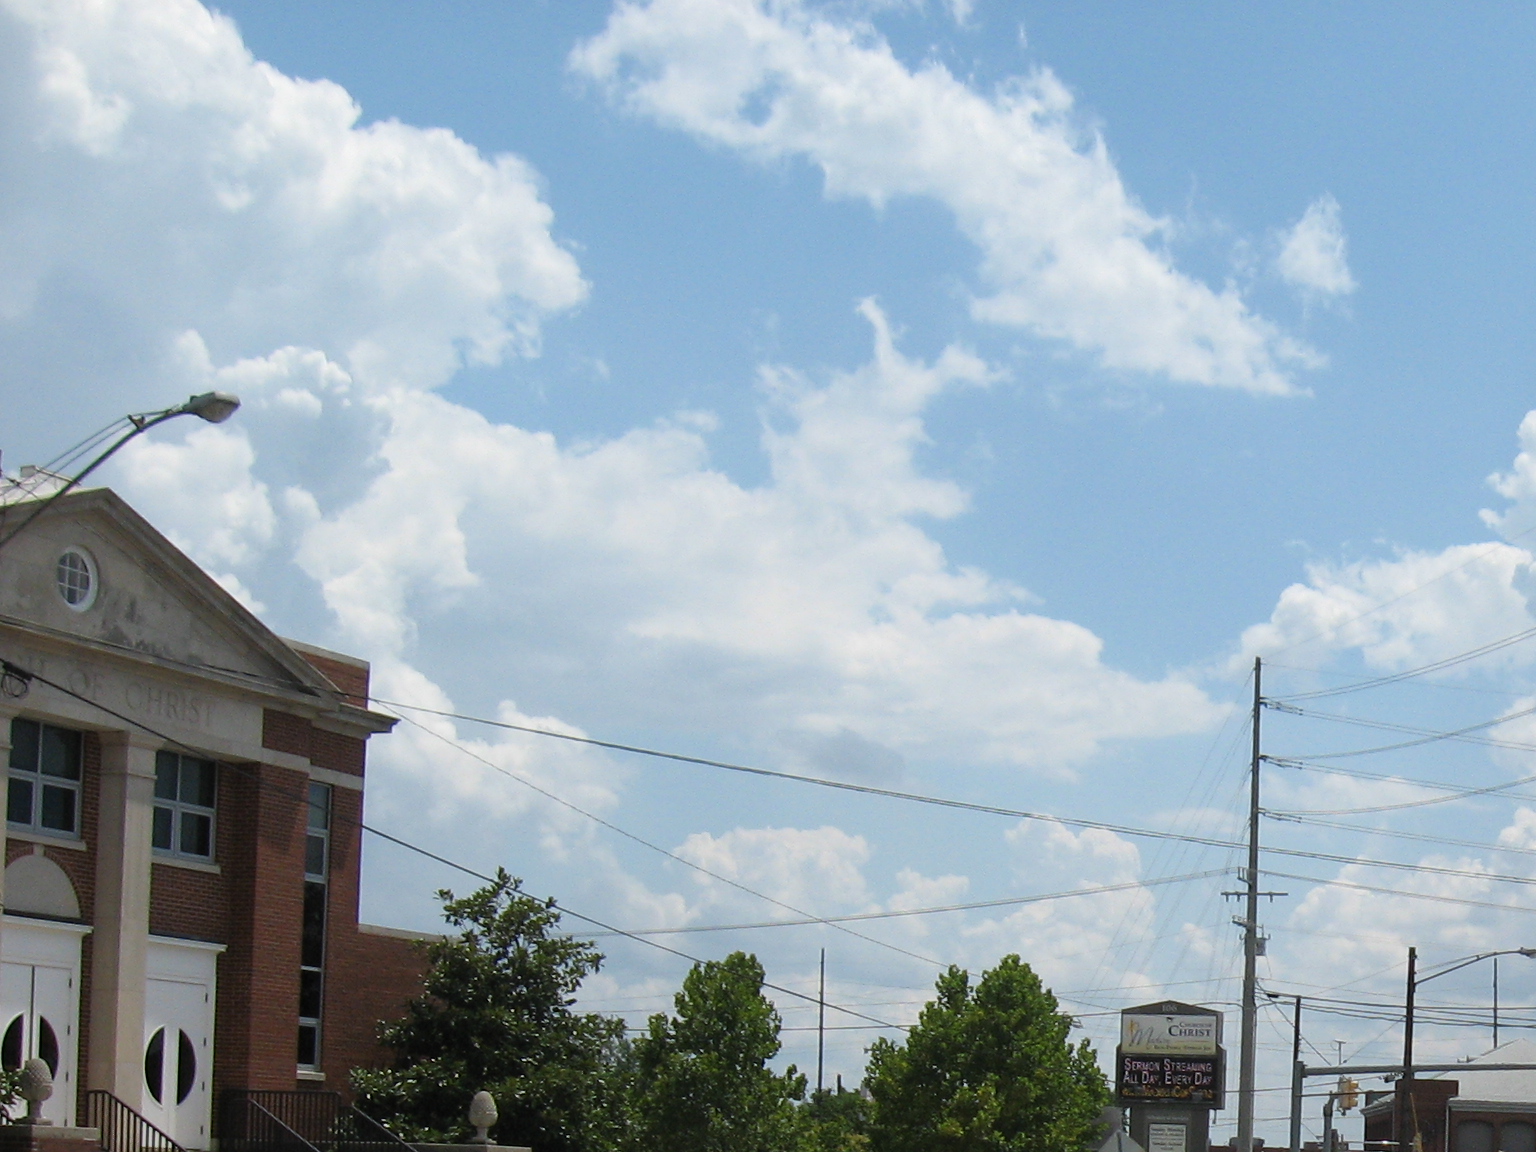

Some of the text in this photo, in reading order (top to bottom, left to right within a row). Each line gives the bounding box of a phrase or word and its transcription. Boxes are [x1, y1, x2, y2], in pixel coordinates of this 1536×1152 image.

[124, 683, 218, 727] CHRIST
[1168, 1025, 1212, 1037] CHRIST
[1124, 1058, 1213, 1072] SERMON STREAMING
[1123, 1071, 1139, 1084] ALL
[1164, 1071, 1192, 1085] EVERY
[1194, 1072, 1213, 1085] DAY
